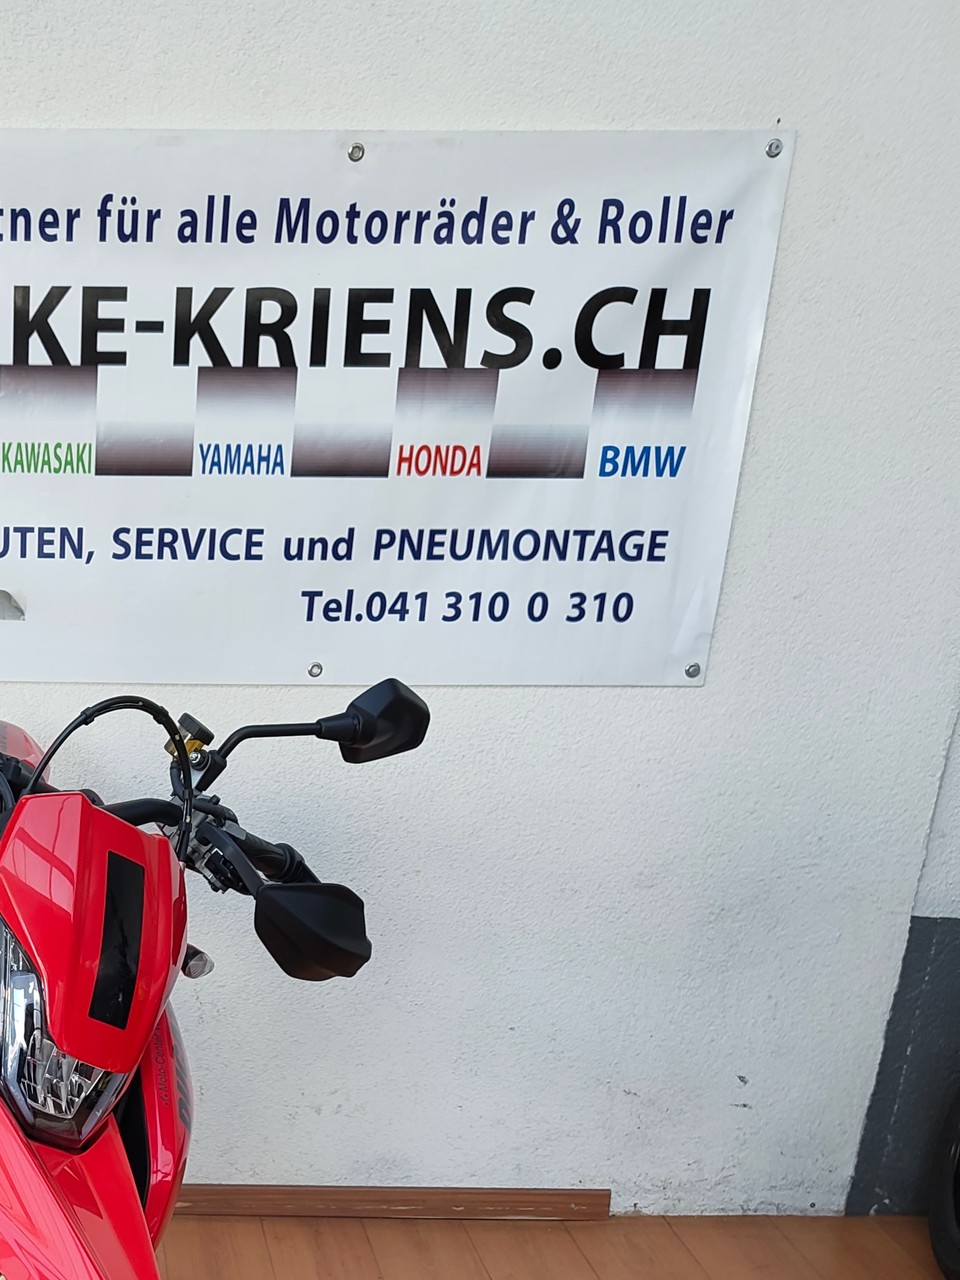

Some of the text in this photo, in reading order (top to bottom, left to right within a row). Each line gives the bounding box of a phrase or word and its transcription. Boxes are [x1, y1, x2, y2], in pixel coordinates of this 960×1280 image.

[96, 193, 162, 244] für
[177, 194, 258, 244] alle
[274, 195, 536, 246] Motorräder
[550, 197, 582, 246] &
[597, 195, 735, 245] Roller
[1, 442, 93, 475] KAWASAKI
[198, 443, 285, 476] YAMAHA
[396, 445, 482, 477] HONDA
[598, 445, 687, 478] BMW
[111, 527, 265, 561] SERVICE
[283, 527, 356, 562] und
[372, 528, 670, 563] PNEUMONTAGE
[300, 588, 634, 624] Tel.041 310 0 310
